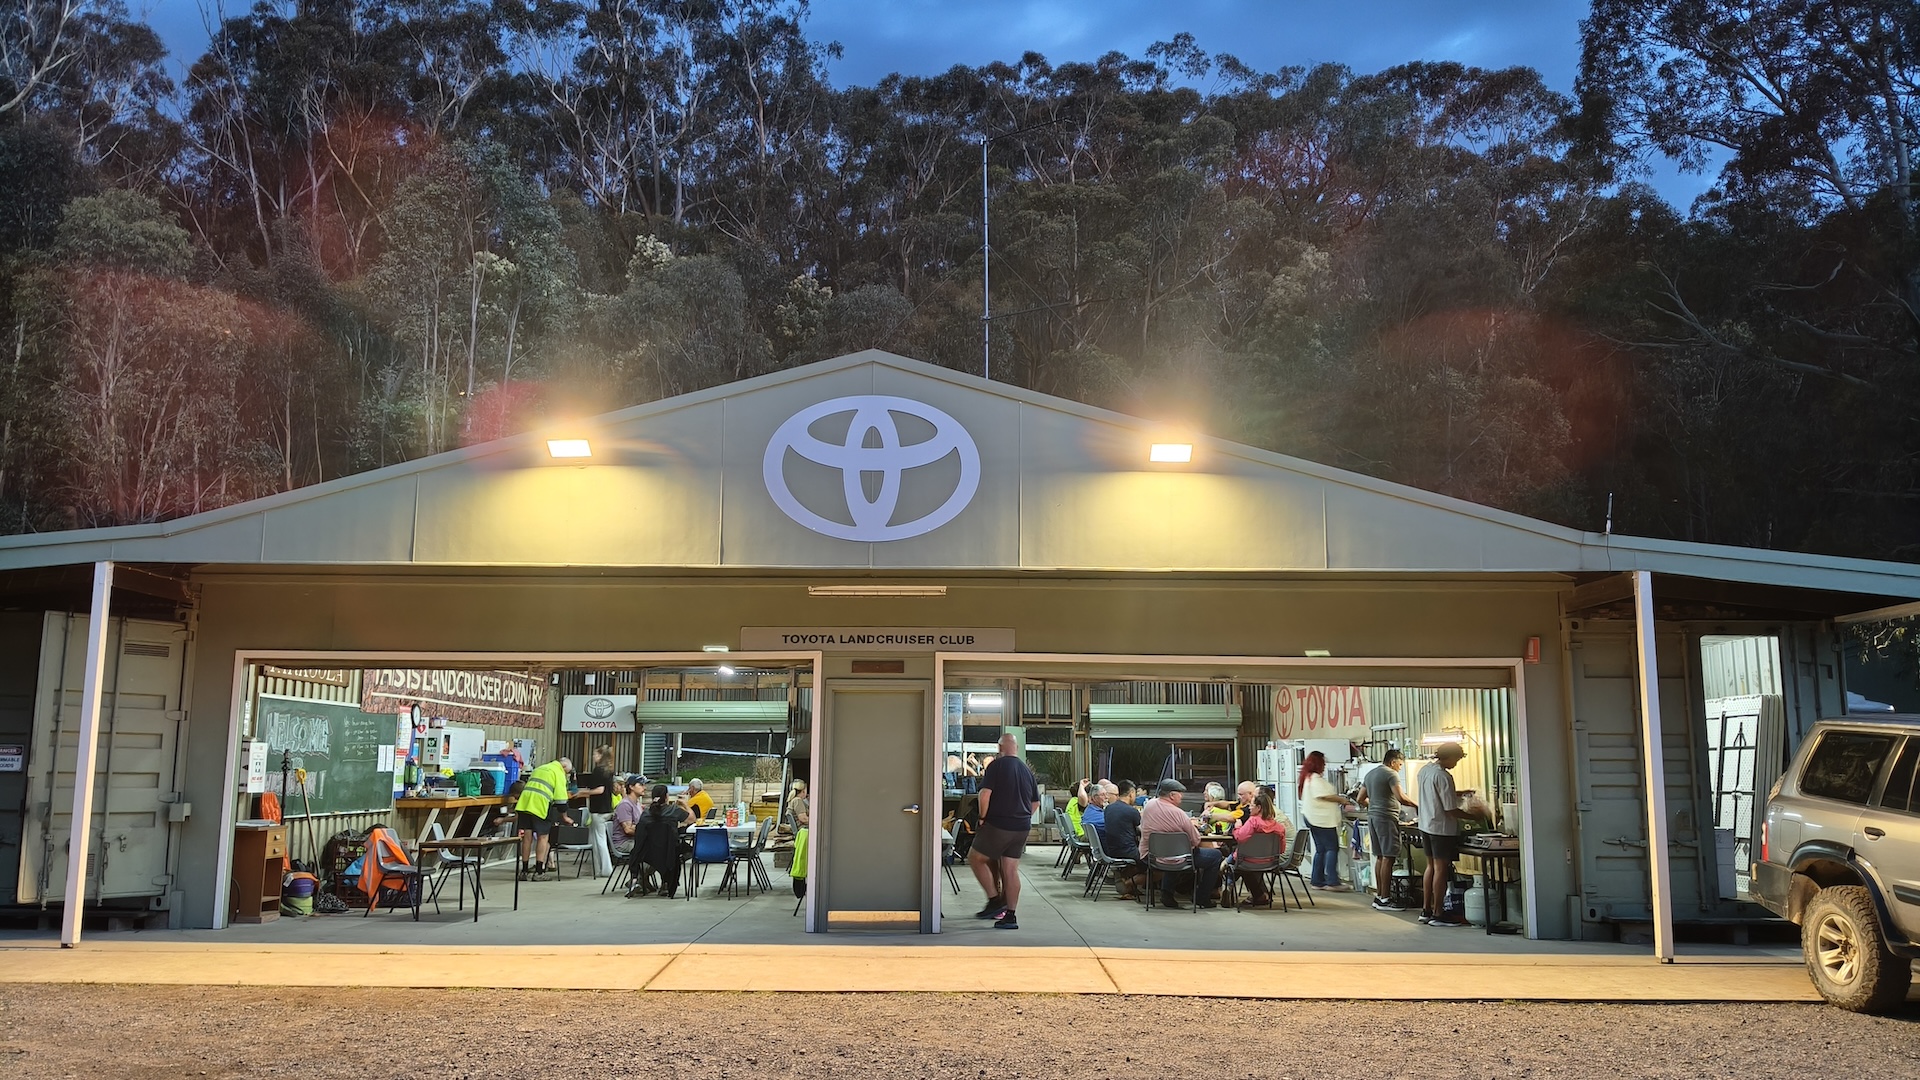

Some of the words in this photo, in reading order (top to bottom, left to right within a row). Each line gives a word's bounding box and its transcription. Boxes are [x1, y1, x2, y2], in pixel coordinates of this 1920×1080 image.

[782, 634, 835, 644] TOYOTA
[840, 634, 935, 645] LANDCRUISER
[939, 635, 975, 645] CLUB
[422, 669, 502, 702] LANDCRUISER
[503, 680, 544, 707] COUNTRY
[1296, 686, 1366, 731] TOYOTA
[266, 712, 330, 754] WELCOME
